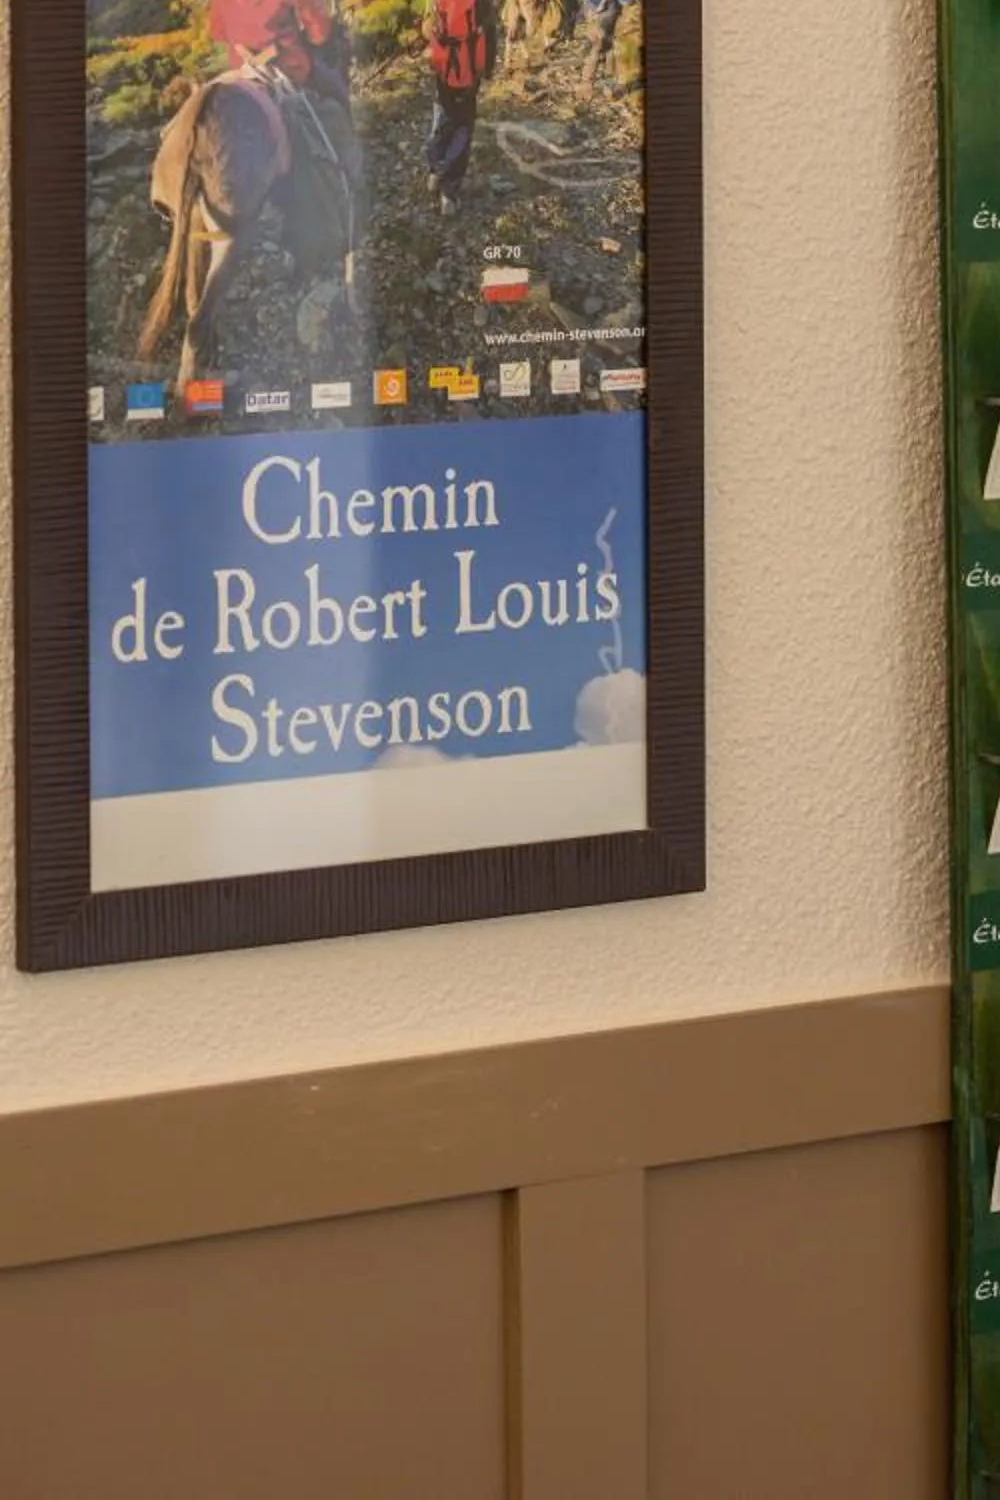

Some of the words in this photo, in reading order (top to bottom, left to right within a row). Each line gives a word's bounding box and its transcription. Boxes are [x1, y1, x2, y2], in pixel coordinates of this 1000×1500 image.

[242, 454, 500, 545] Chemin
[110, 577, 185, 664] de
[212, 562, 428, 655] Robert
[454, 550, 621, 635] Louis
[210, 673, 533, 765] Stevenson
